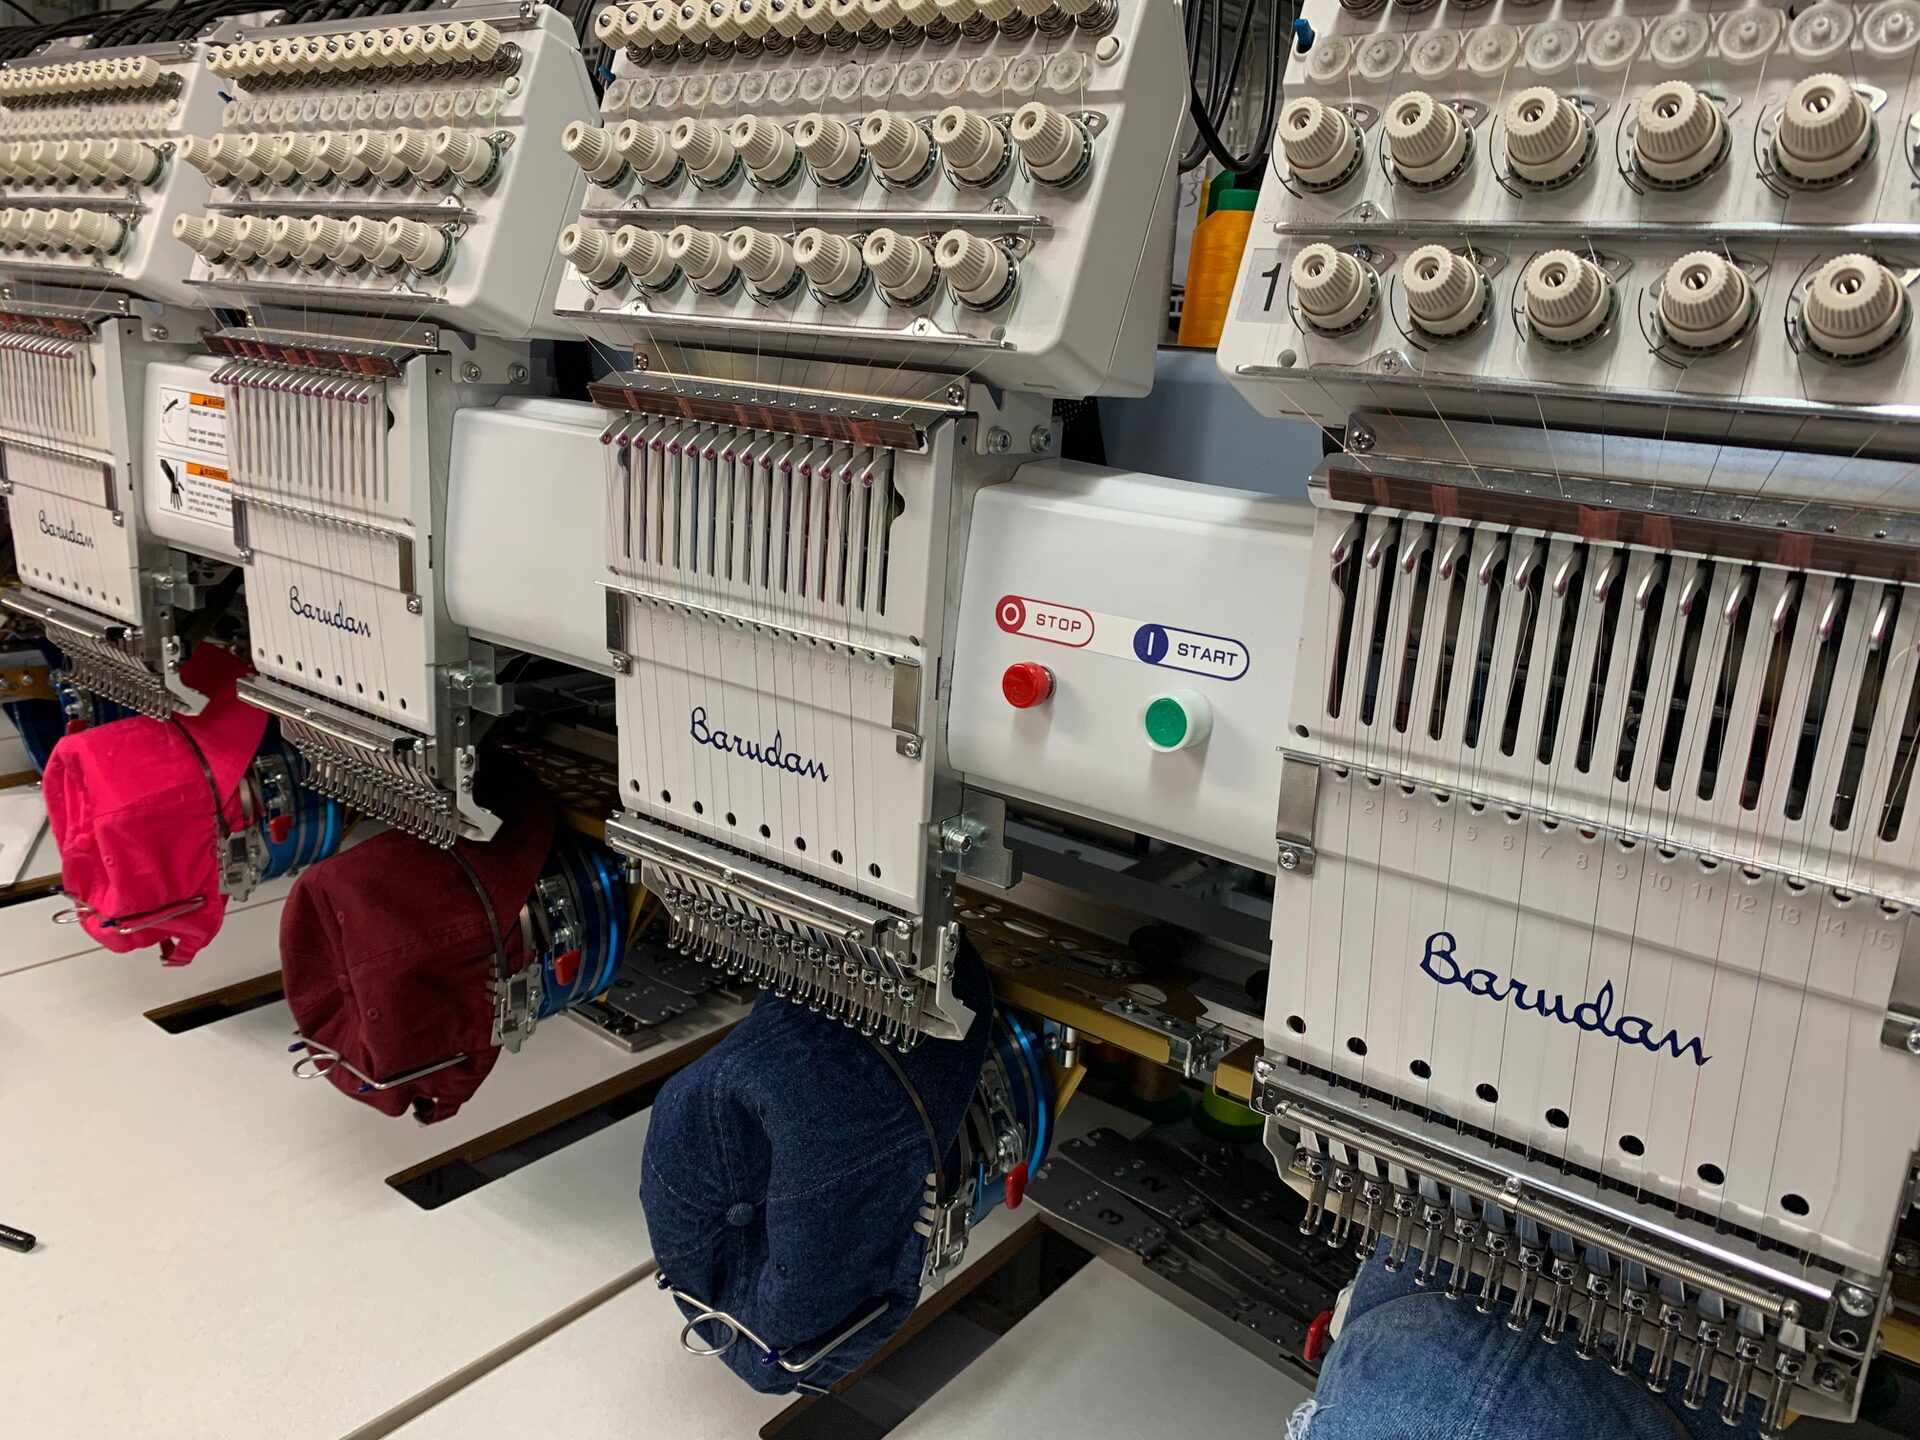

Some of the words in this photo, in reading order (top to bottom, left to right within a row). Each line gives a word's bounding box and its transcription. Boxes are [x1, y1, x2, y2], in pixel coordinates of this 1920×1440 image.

[1261, 262, 1282, 312] 1
[39, 509, 94, 549] Barudan
[289, 585, 371, 638] Barudan
[1035, 613, 1082, 633] STOP
[1176, 642, 1239, 666] START
[690, 706, 829, 783] Barudan
[1362, 799, 1376, 816] 2
[1430, 816, 1443, 832] 4
[1465, 825, 1478, 842] 5
[1502, 834, 1515, 850] 6
[1576, 853, 1589, 870] 8
[1614, 862, 1629, 880] 9
[1650, 872, 1673, 892] 10
[1692, 883, 1713, 903] 11
[1733, 893, 1757, 914] 12
[1776, 904, 1800, 925] 13
[1821, 916, 1847, 937] 14
[1868, 928, 1894, 950] 15
[1419, 931, 1713, 1067] Barudan
